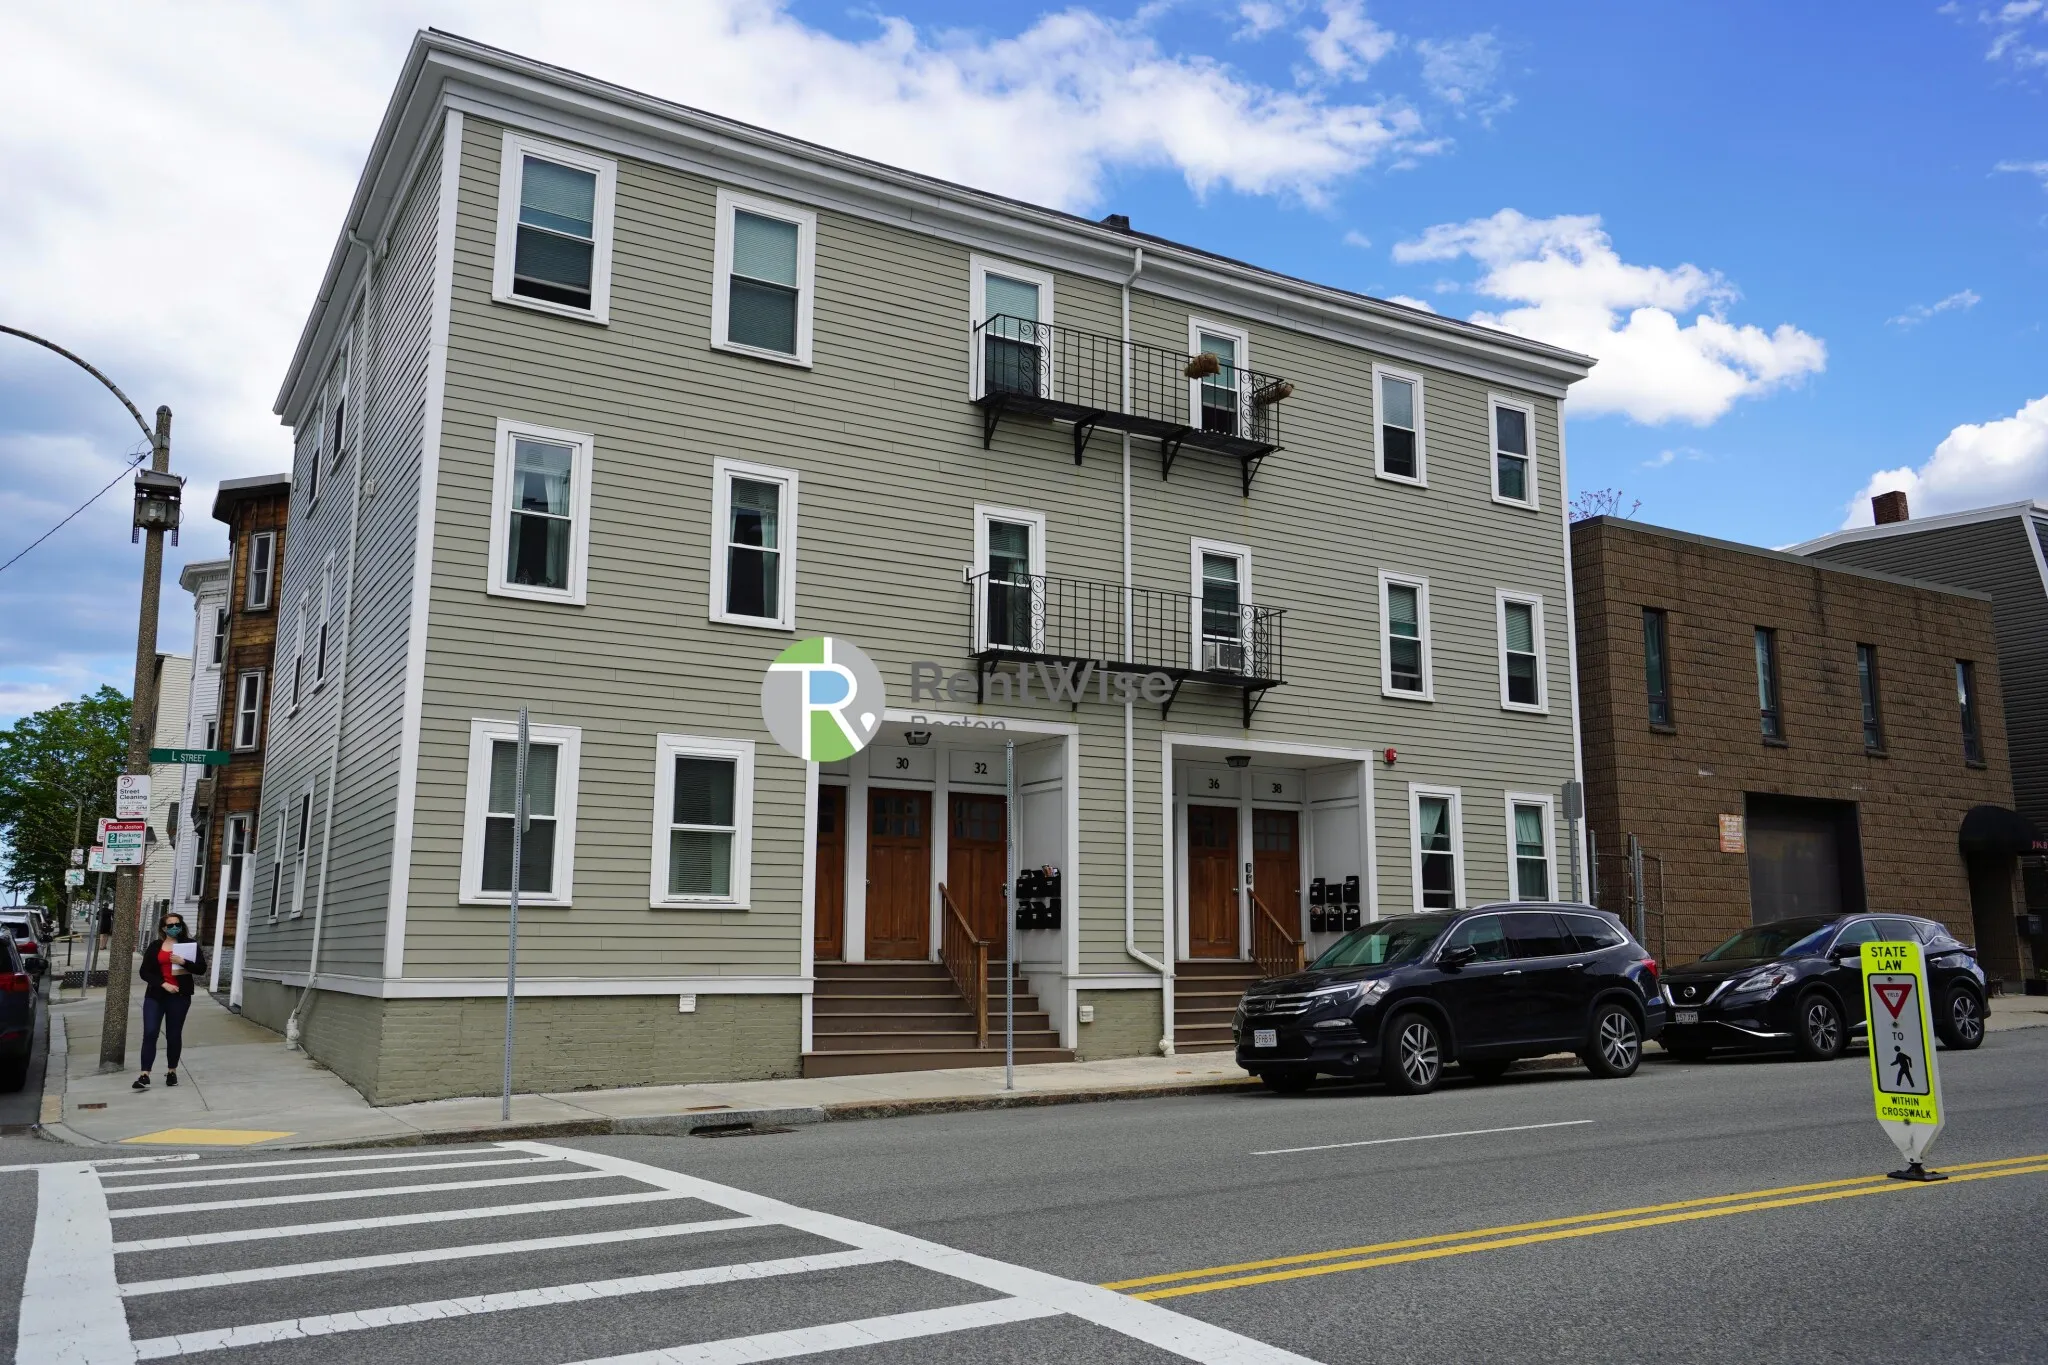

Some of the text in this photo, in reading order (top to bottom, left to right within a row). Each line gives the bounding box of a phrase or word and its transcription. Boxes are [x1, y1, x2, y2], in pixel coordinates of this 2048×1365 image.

[171, 751, 207, 763] L STREET
[896, 757, 909, 769] 30
[974, 762, 988, 775] 32
[1208, 778, 1220, 789] 36
[1271, 783, 1282, 794] 38
[109, 833, 116, 841] 2
[1871, 946, 1908, 958] STATE
[1877, 960, 1902, 971] LAW
[1891, 1031, 1904, 1041] TO
[1891, 1096, 1920, 1106] WITHIN
[1881, 1107, 1931, 1119] CROSSWALK
